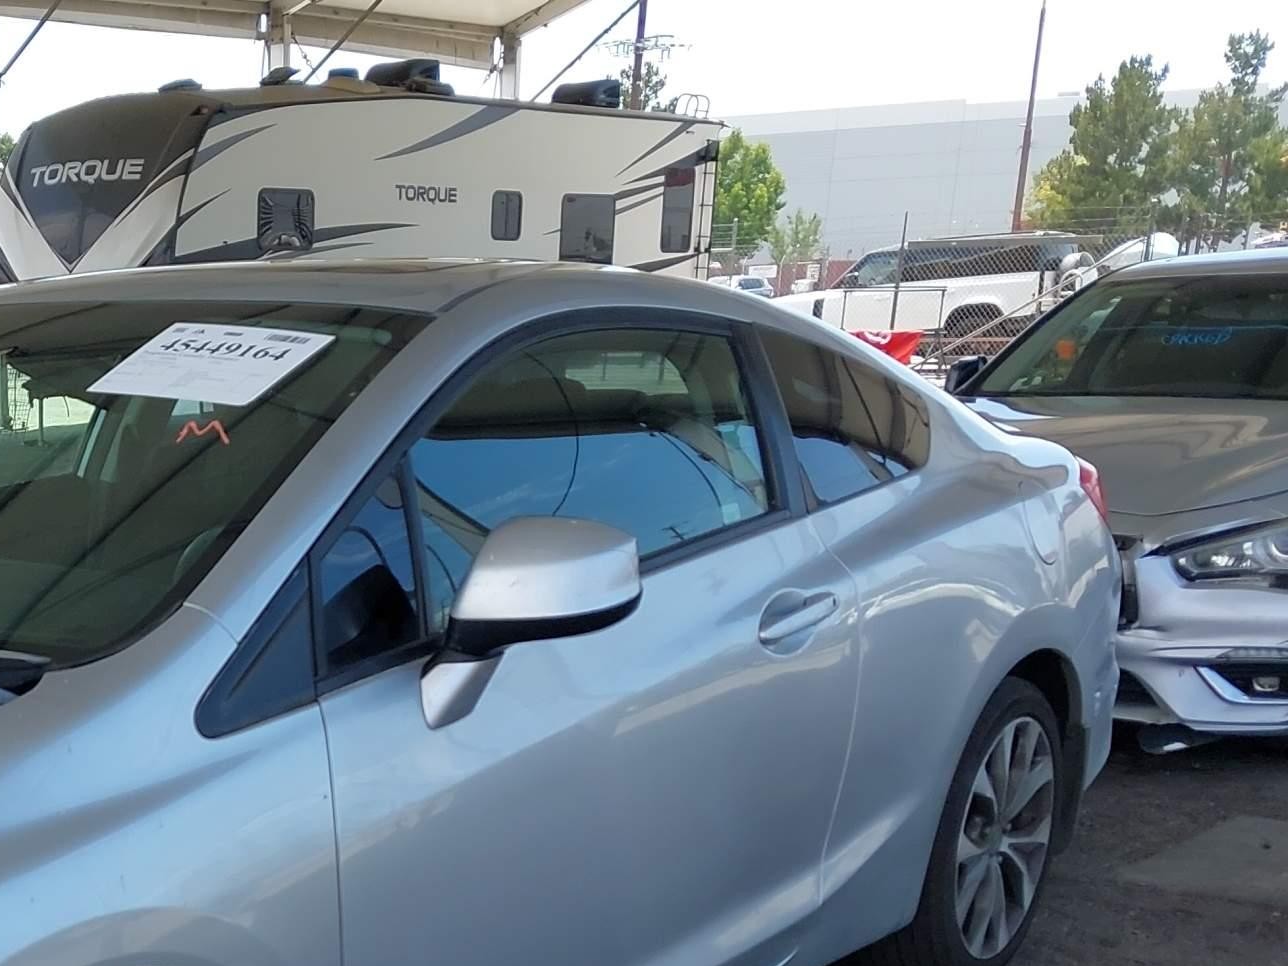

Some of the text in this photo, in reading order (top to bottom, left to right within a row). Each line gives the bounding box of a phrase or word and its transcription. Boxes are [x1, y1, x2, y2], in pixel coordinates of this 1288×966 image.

[30, 158, 145, 188] TORQUE
[394, 184, 458, 205] TORQUE
[159, 338, 293, 362] 45449164
